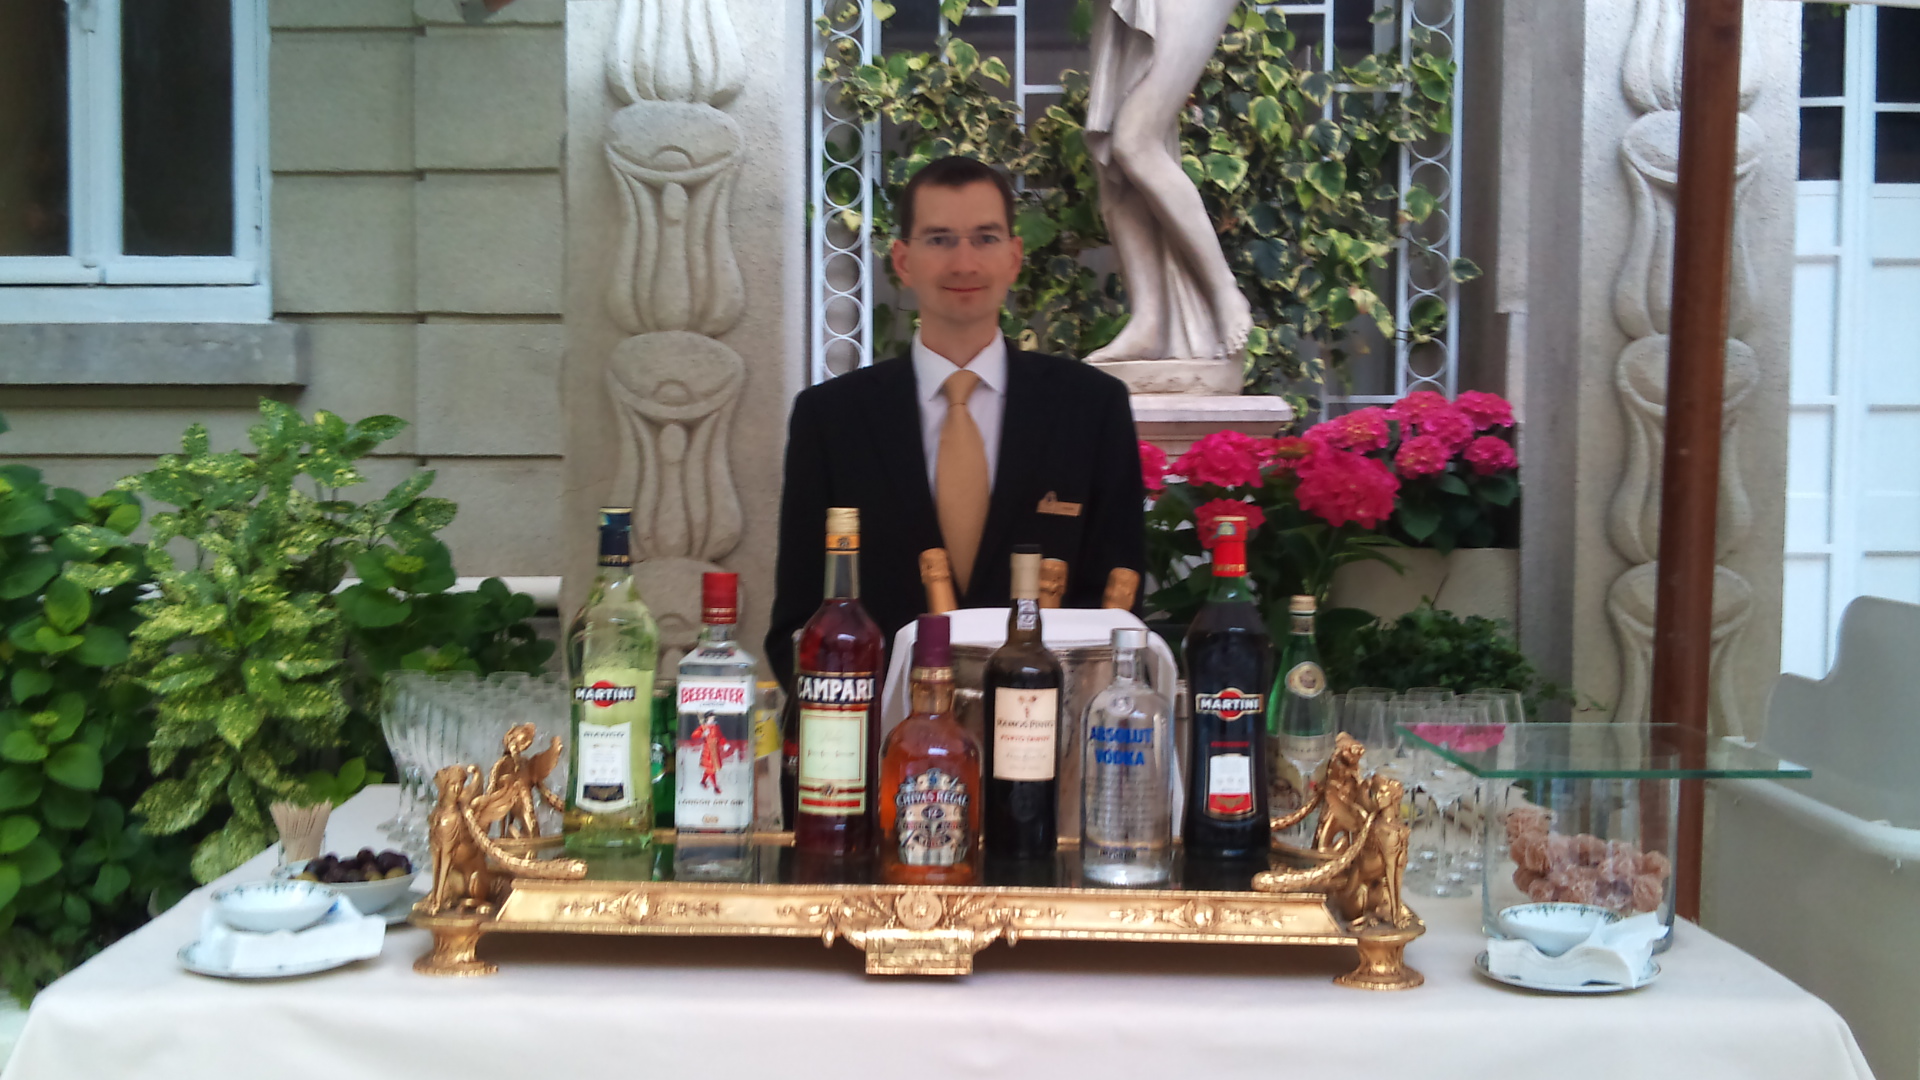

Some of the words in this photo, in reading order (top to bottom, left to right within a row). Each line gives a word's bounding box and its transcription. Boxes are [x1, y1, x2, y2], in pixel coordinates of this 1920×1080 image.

[575, 687, 635, 701] MARTINI
[681, 687, 745, 704] BEEFEATER
[798, 676, 875, 702] CAMPARI
[1200, 698, 1260, 711] MARTINI
[1090, 726, 1154, 743] ABSOLUT
[1094, 749, 1145, 766] VODKA
[896, 790, 935, 807] CHIVAS
